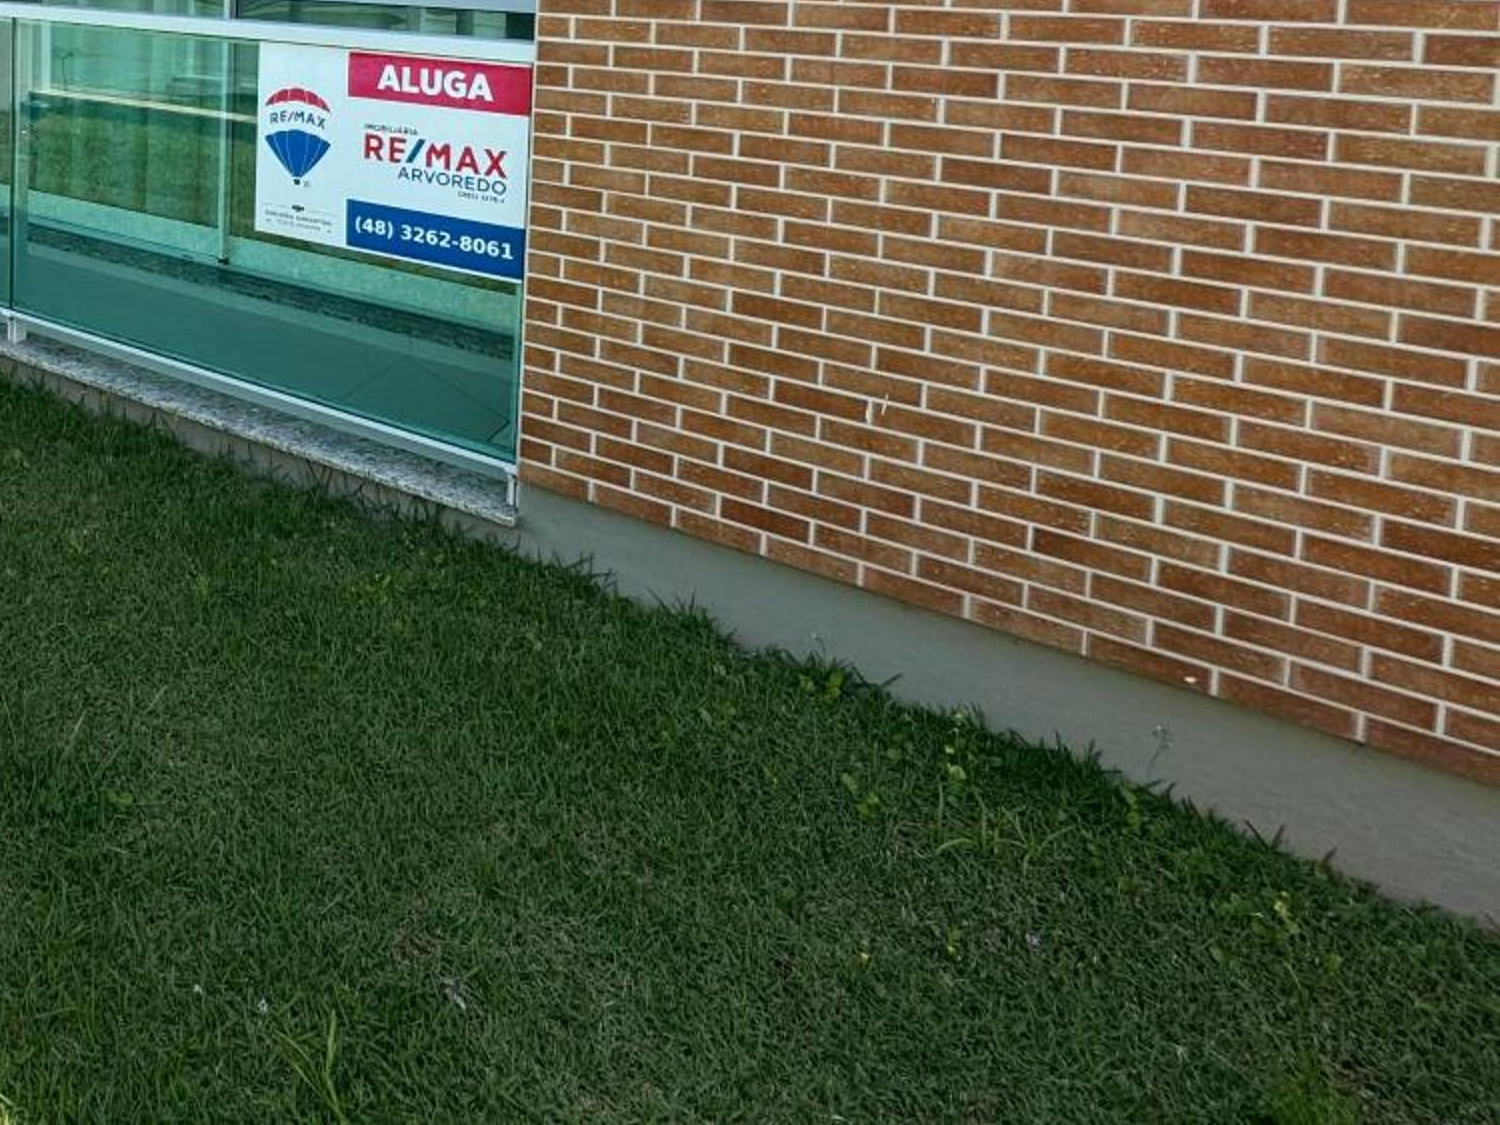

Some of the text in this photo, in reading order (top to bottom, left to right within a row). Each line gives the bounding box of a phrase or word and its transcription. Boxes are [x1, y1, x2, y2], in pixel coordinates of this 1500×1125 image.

[377, 64, 494, 102] ALUGA
[269, 110, 326, 129] RE/MAX
[364, 132, 508, 179] RE/MAX
[398, 166, 507, 196] ARVOREDO
[355, 216, 393, 240] (48)
[401, 224, 514, 260] 3262-8061
